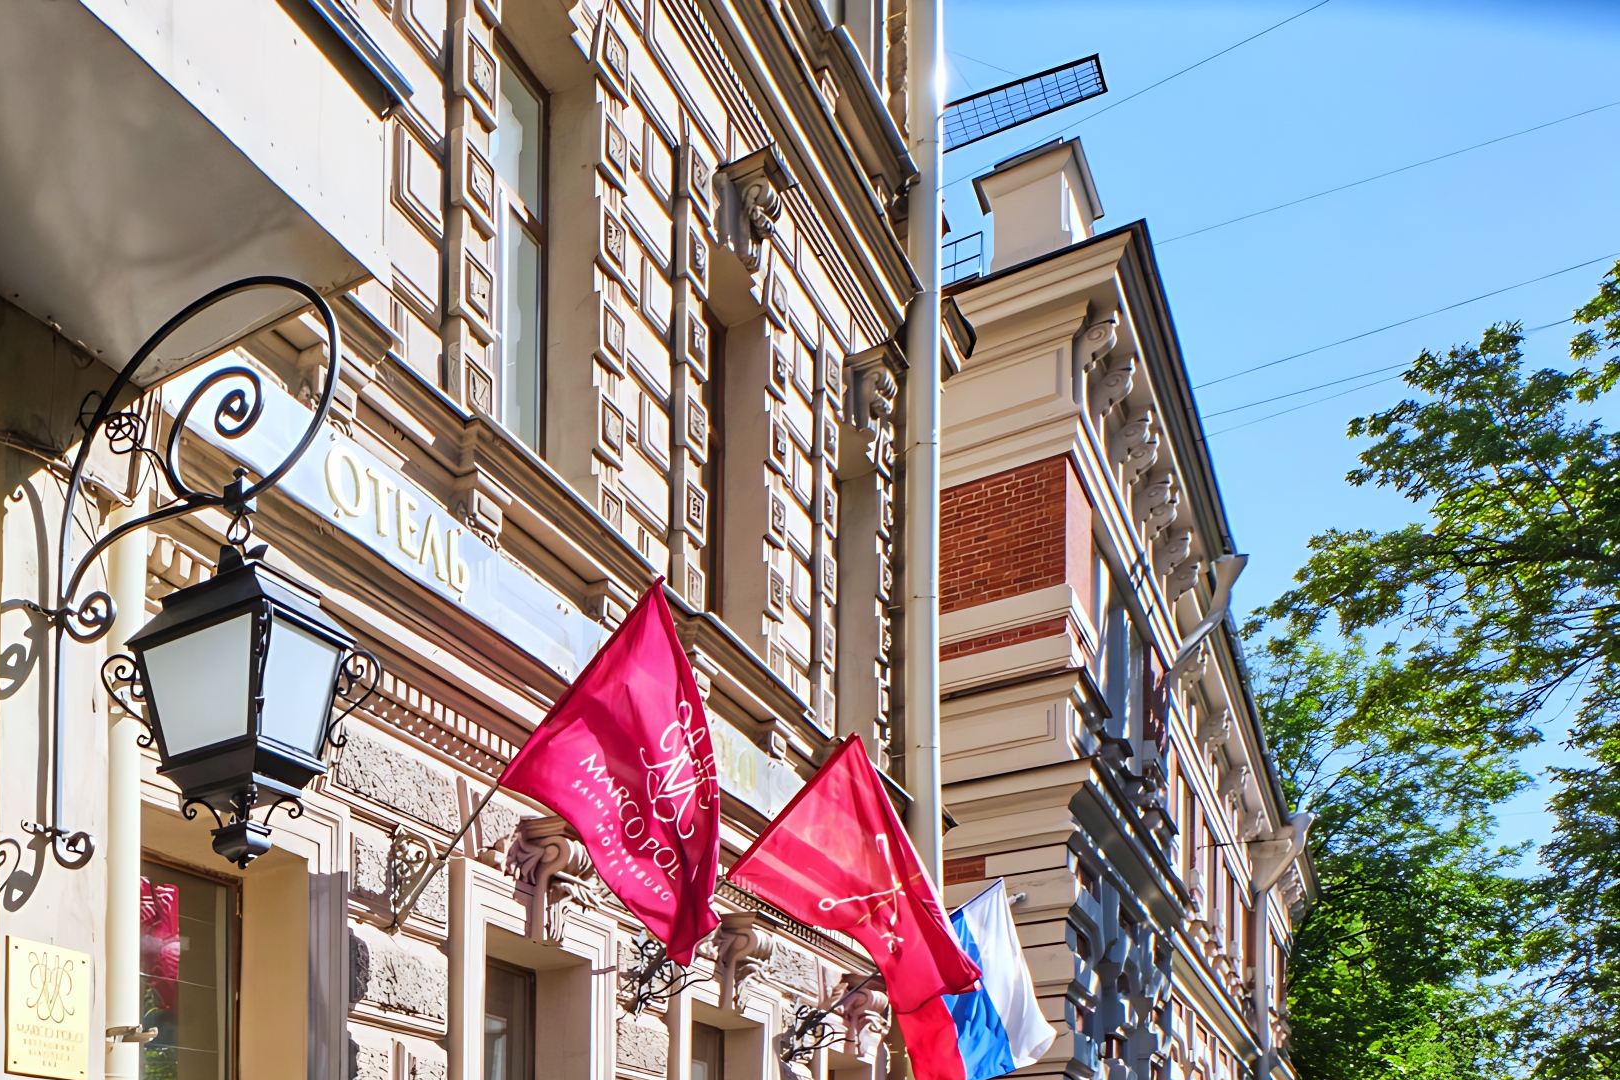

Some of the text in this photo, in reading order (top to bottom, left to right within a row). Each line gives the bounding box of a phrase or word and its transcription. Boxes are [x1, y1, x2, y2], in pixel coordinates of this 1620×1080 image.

[324, 446, 471, 594] ОТЕЛЬ
[580, 754, 683, 881] MARCO POL
